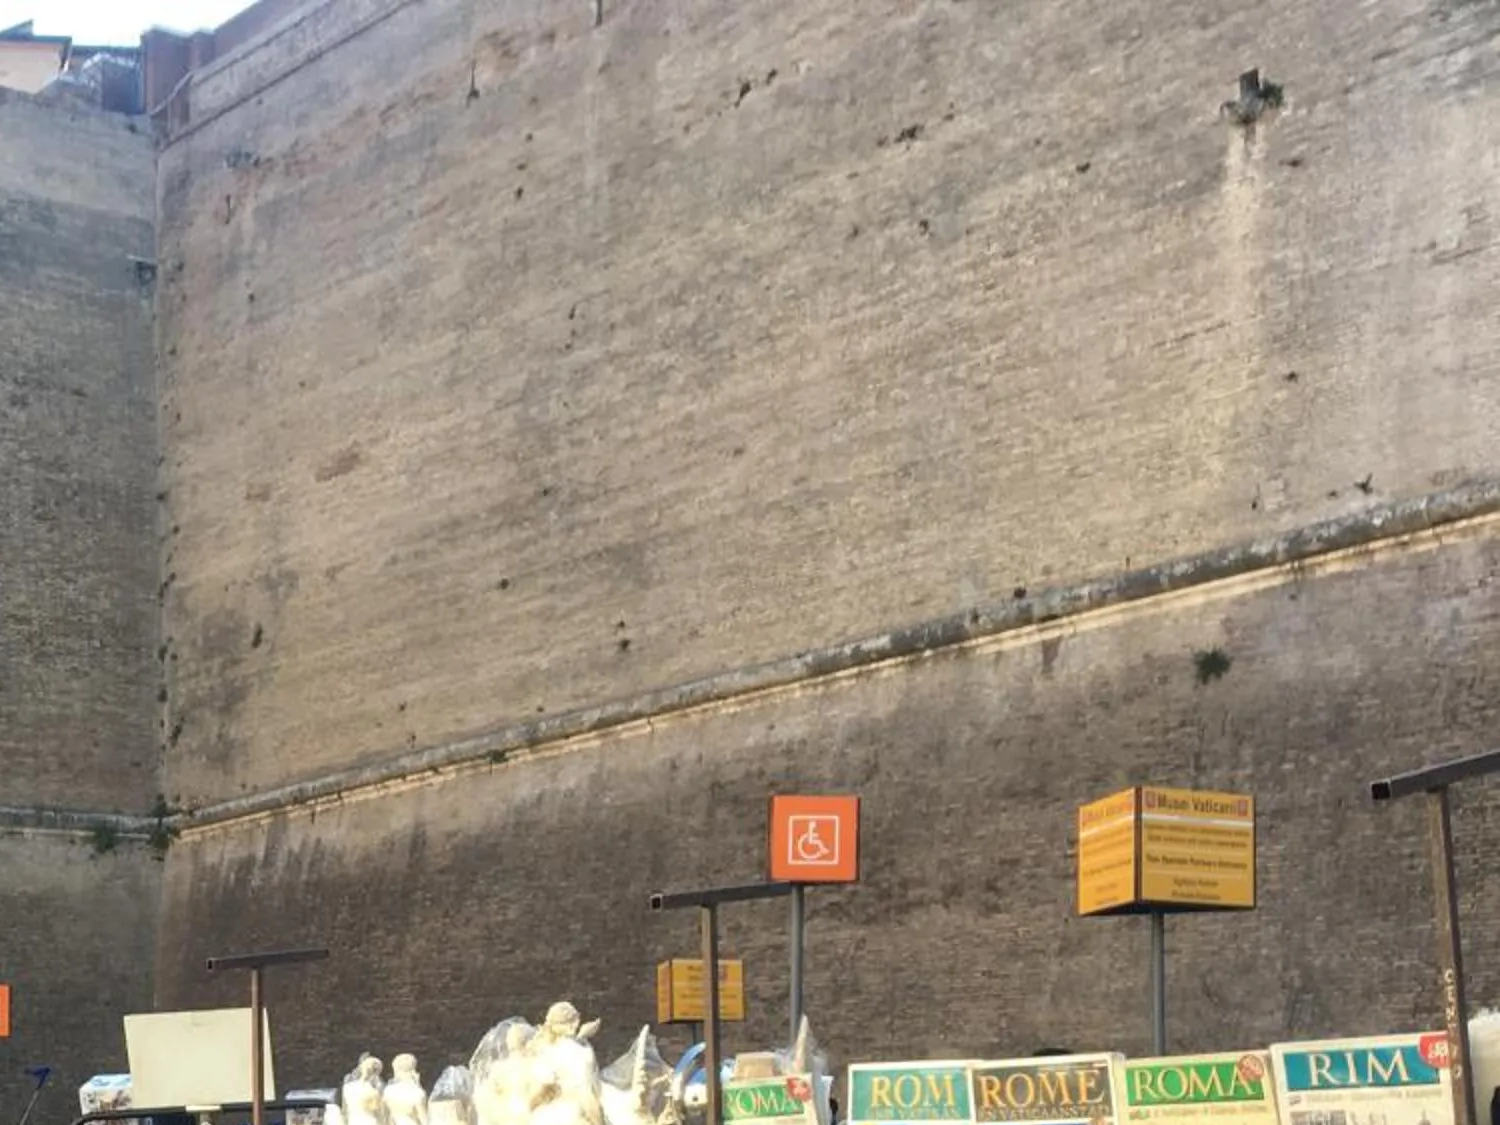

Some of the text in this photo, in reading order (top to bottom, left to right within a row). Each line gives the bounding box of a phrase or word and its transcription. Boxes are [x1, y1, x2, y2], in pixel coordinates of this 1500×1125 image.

[1133, 1064, 1256, 1101] ROMA
[1307, 1047, 1412, 1087] RIM
[870, 1071, 957, 1108] ROM
[979, 1069, 1106, 1110] ROME
